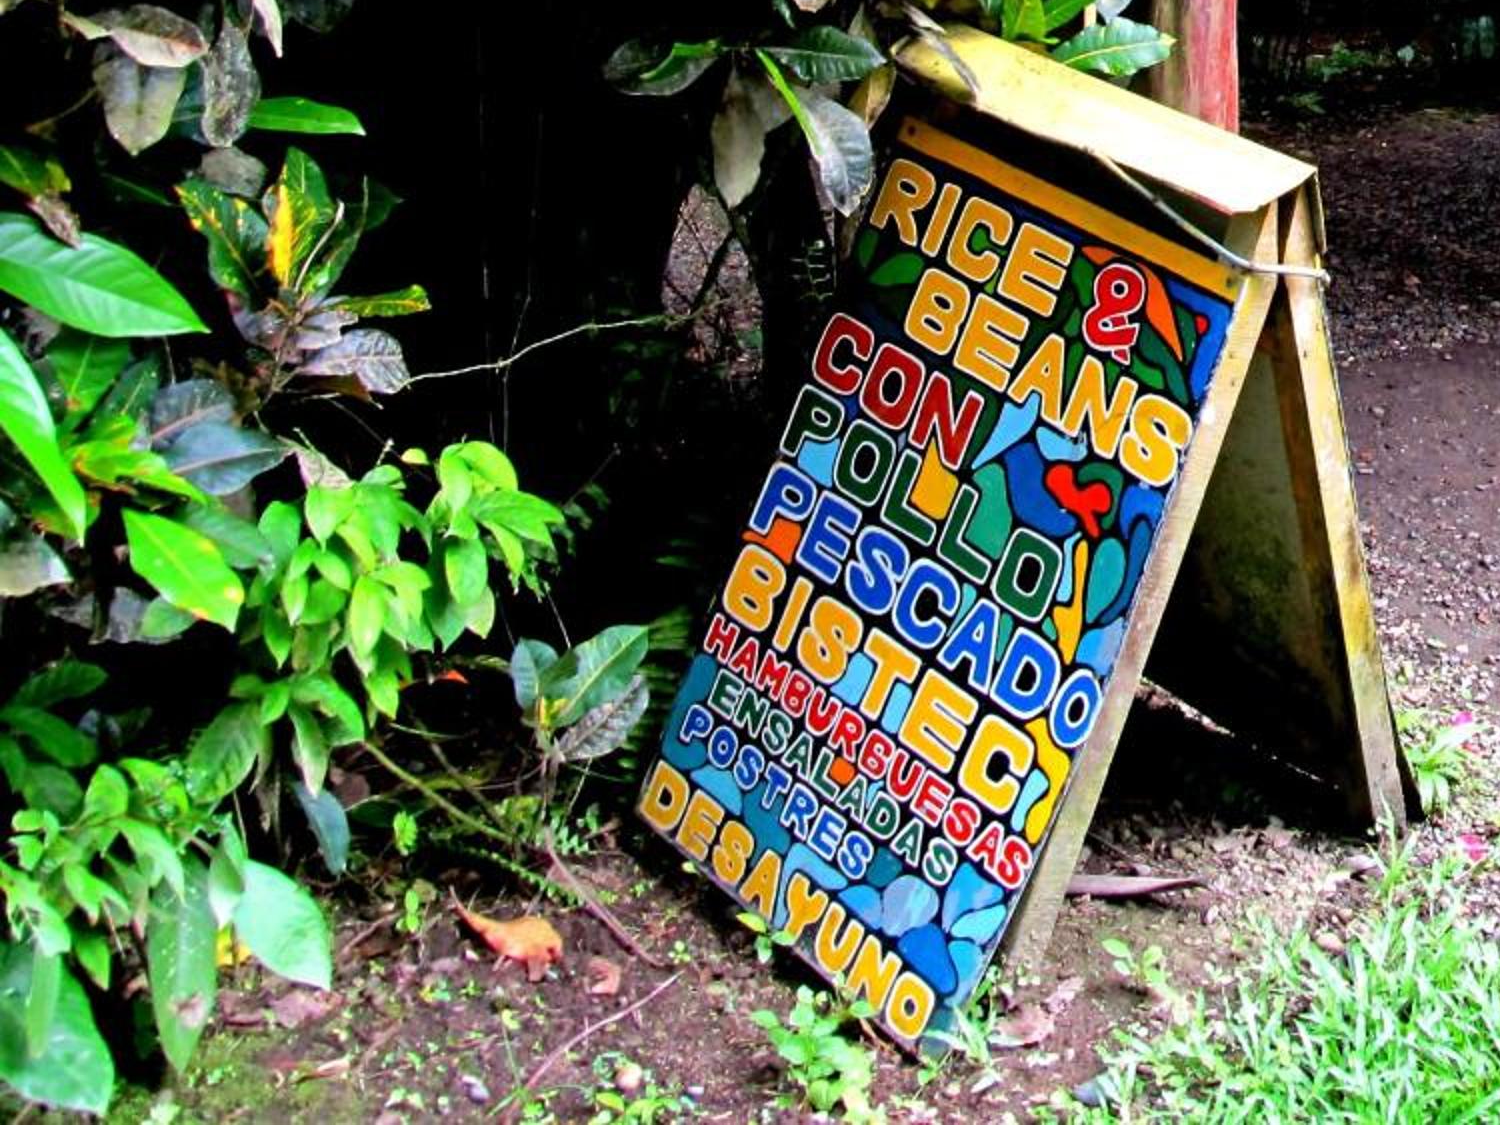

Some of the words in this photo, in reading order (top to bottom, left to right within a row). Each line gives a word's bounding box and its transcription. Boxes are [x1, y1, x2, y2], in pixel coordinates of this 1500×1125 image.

[869, 158, 1075, 318] RICE
[1082, 262, 1147, 365] &
[813, 312, 985, 471] CON
[903, 267, 1193, 487] BEANS
[748, 461, 1103, 749] PESCADO
[778, 384, 1063, 624] POLLO
[707, 668, 958, 886] ENSALADAS
[723, 543, 1036, 815] BISTEC
[639, 759, 936, 1040] DESAYUNO
[679, 704, 874, 880] POSTRES
